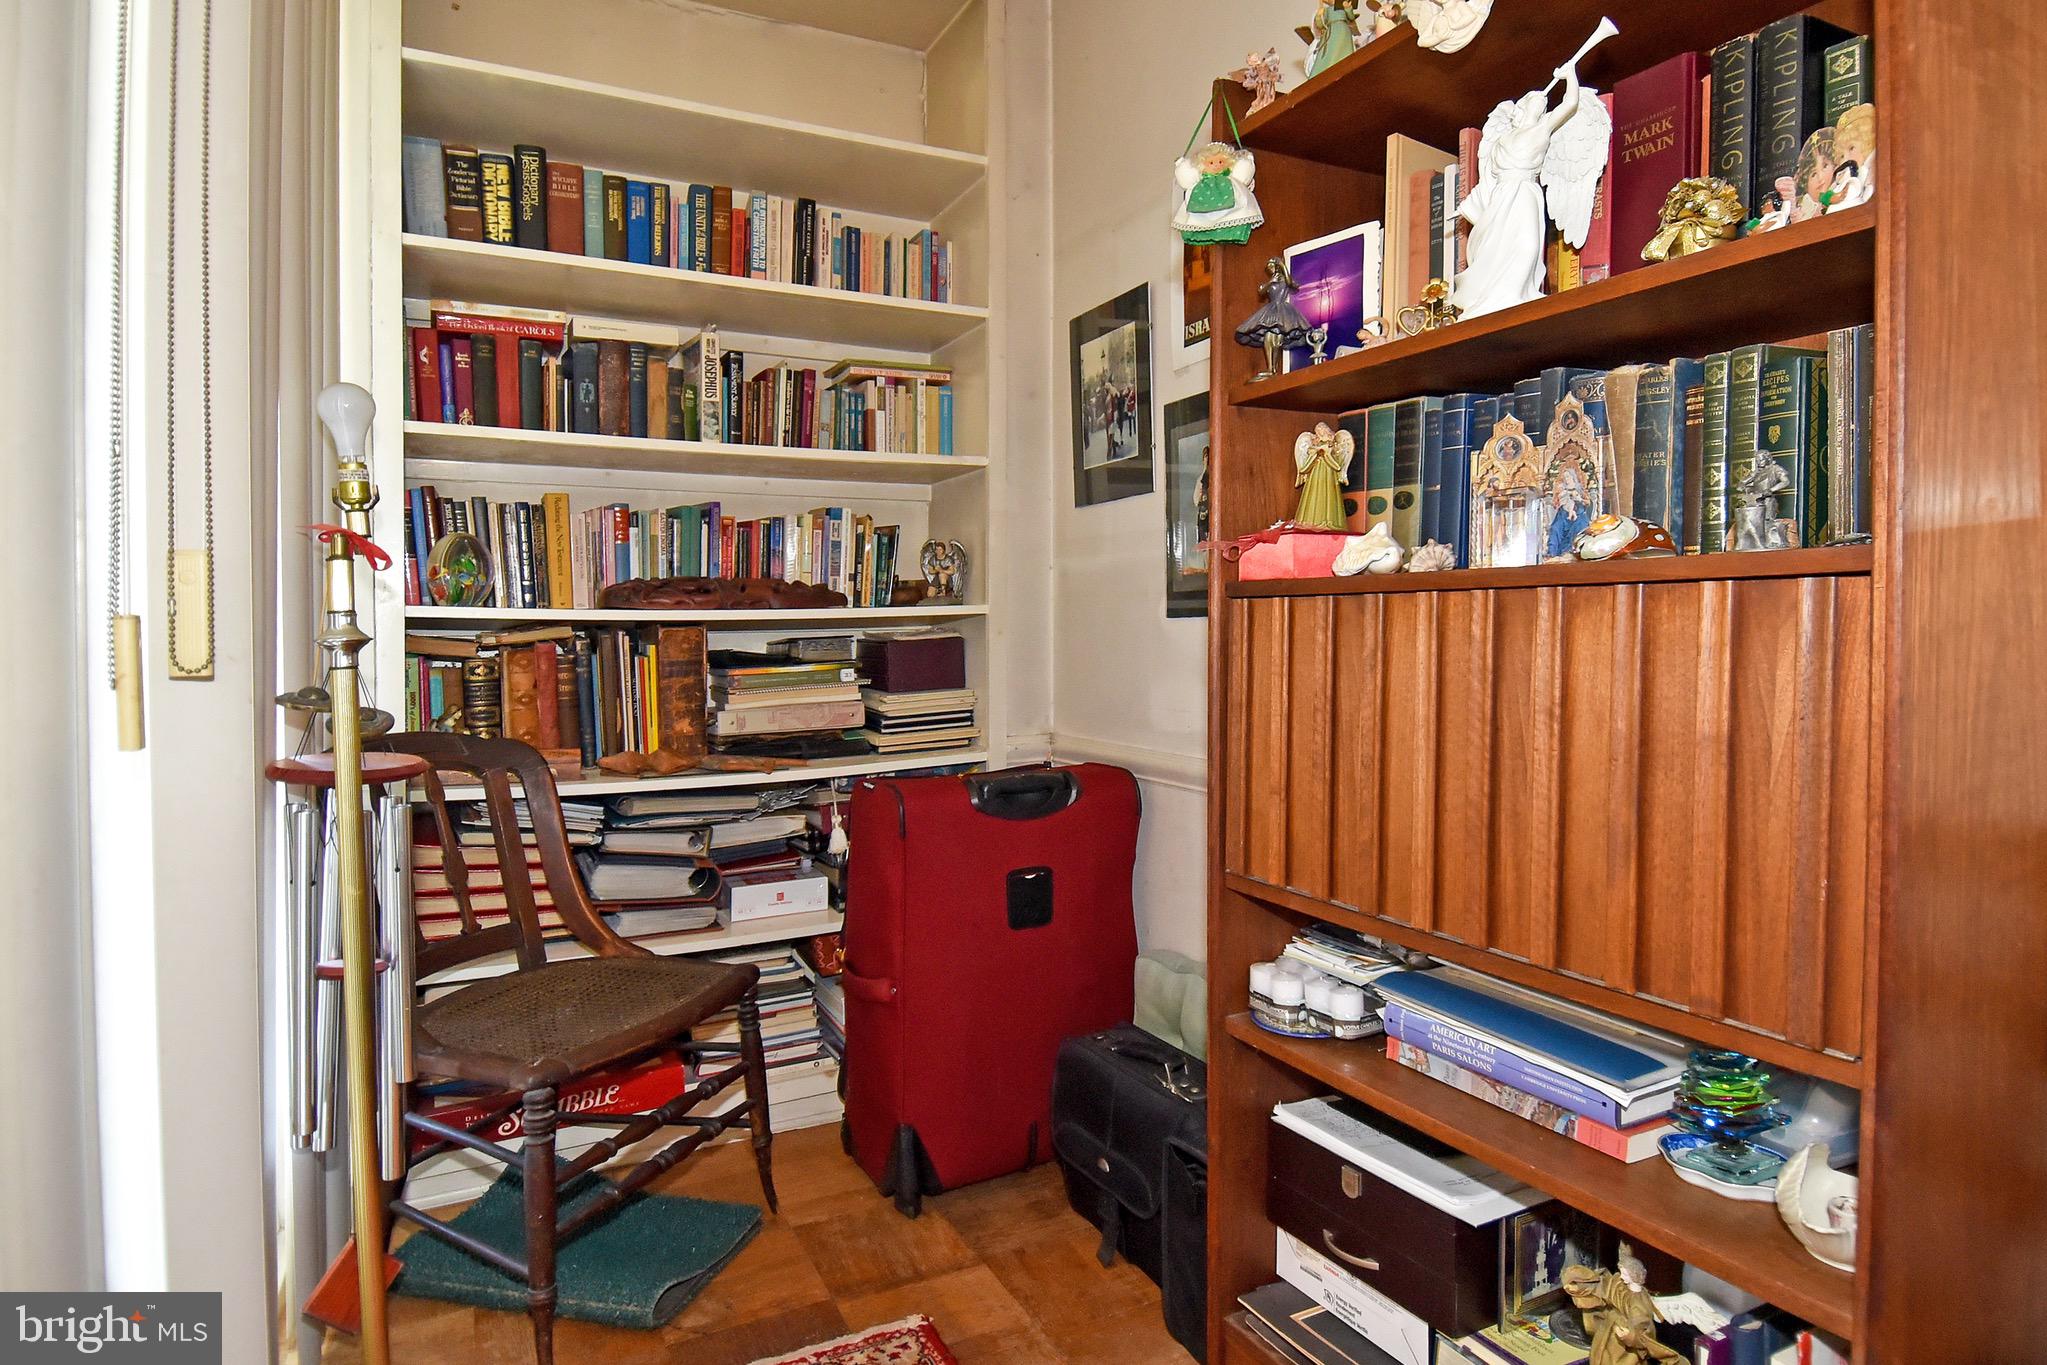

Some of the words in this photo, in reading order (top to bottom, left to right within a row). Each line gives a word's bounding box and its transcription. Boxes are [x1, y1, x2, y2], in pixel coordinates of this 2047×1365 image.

[1771, 27, 1798, 154] KIPLING
[1721, 46, 1745, 170] KIPLING
[1624, 116, 1674, 146] MARK
[1621, 132, 1675, 164] TWAIN
[496, 164, 511, 200] NEW
[529, 156, 541, 207] Dictionary
[552, 183, 577, 192] BIBLE
[482, 162, 498, 242] DICTIONARY
[695, 193, 706, 208] THE
[498, 200, 513, 243] BIBLE
[695, 209, 706, 231] UNITY
[759, 209, 767, 259] INTRODUCTION
[695, 236, 706, 258] BIBLE
[515, 326, 555, 336] CAROLS
[704, 355, 718, 399] JOSEPHUS
[1763, 374, 1790, 386] RECIPES
[1430, 1024, 1476, 1048] AMERICAN
[1477, 1042, 1497, 1055] ART
[1432, 1041, 1456, 1057] PARIS
[1457, 1052, 1494, 1073] SALONS
[497, 1084, 620, 1137] SBBLE
